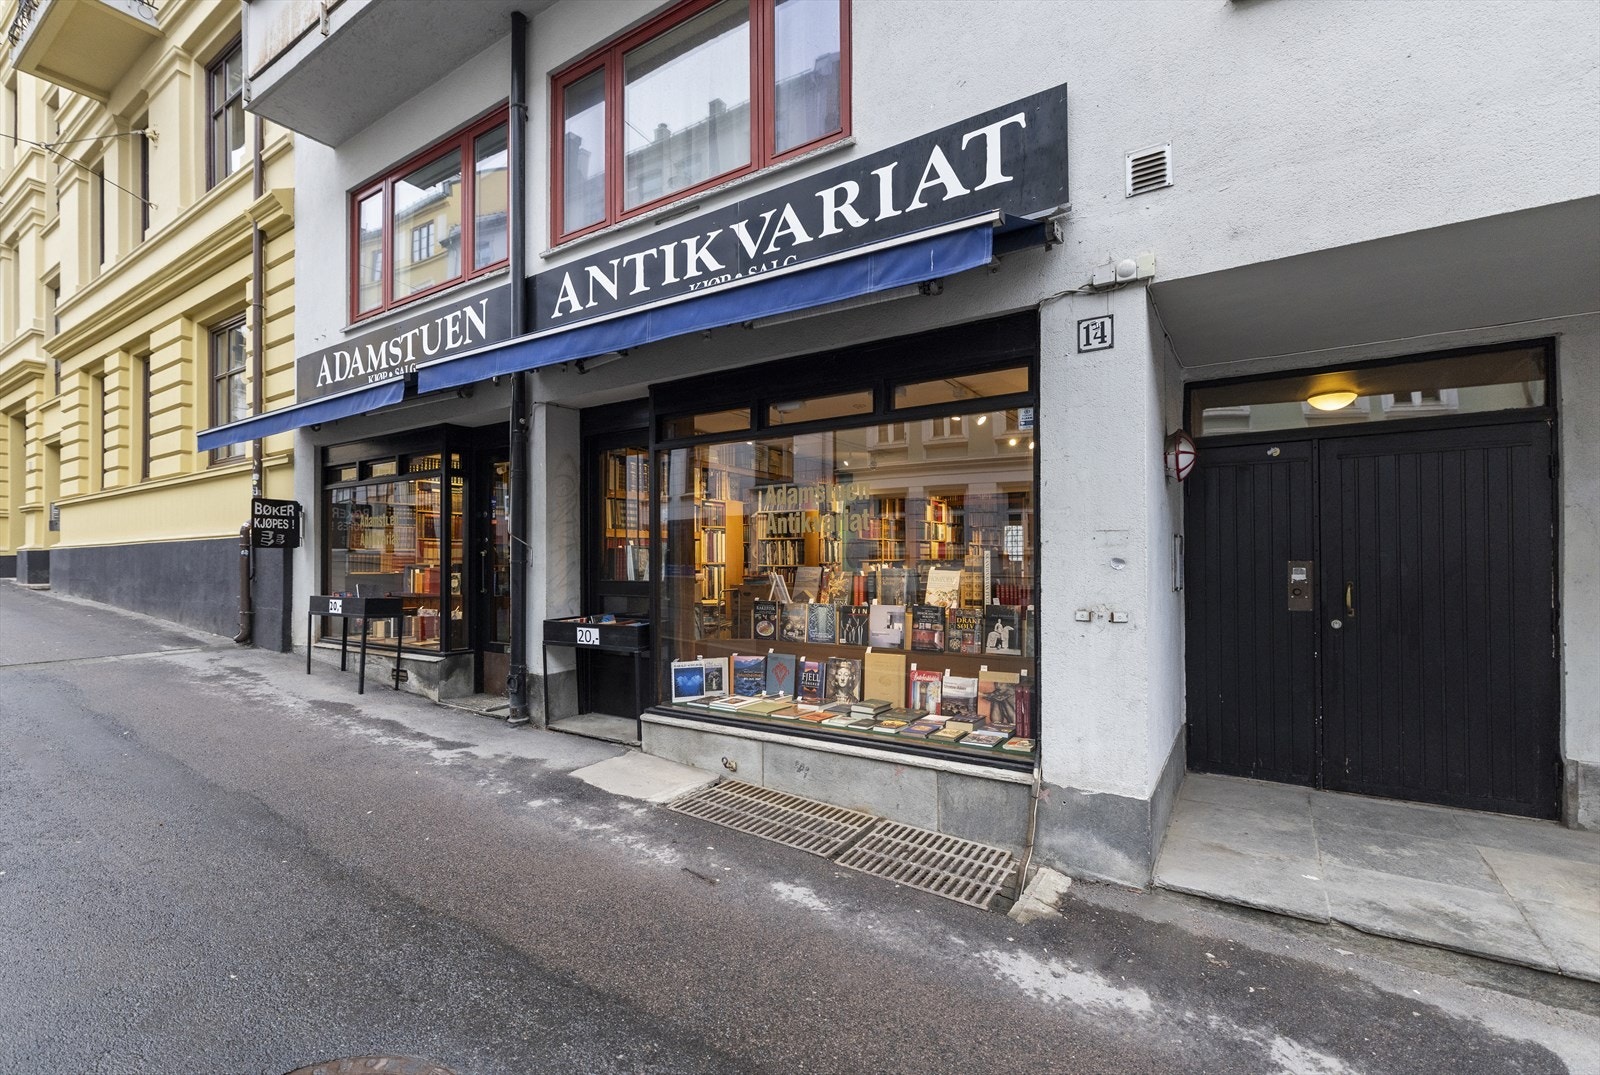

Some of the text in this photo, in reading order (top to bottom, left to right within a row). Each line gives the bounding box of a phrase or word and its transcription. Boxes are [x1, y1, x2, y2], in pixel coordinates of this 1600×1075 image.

[550, 111, 1028, 319] ANTIKVARIAT
[316, 297, 489, 388] ADAMSTUEN
[1082, 320, 1108, 347] 14
[765, 481, 871, 506] Adamstuen
[254, 502, 295, 517] BØKER
[765, 508, 870, 535] Antikvariat
[254, 517, 290, 530] KJØPES
[578, 629, 599, 645] 20,-
